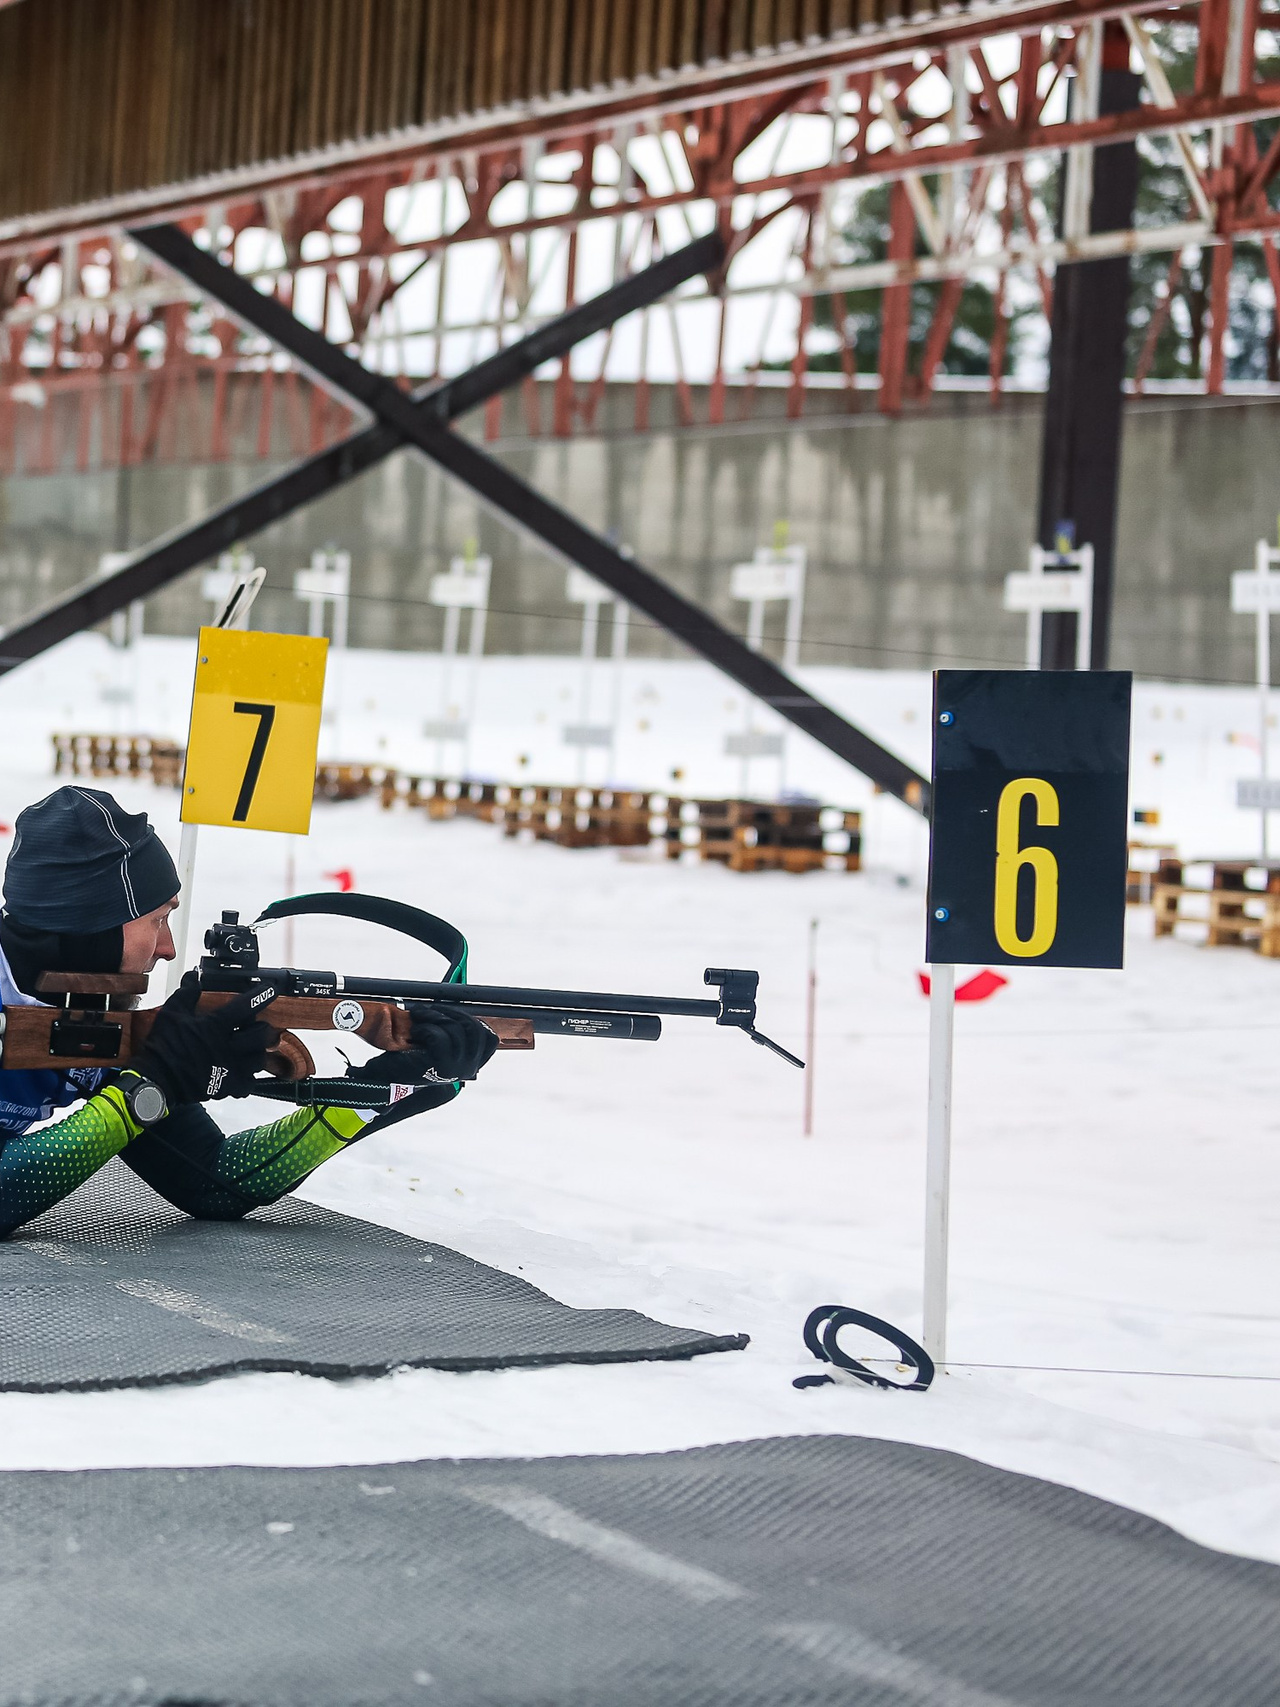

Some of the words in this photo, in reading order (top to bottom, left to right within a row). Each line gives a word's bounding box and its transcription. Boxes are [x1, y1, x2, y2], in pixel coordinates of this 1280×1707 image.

[232, 701, 275, 822] 7
[994, 777, 1060, 958] 6
[251, 986, 275, 1009] KV+
[206, 1065, 218, 1095] PRO
